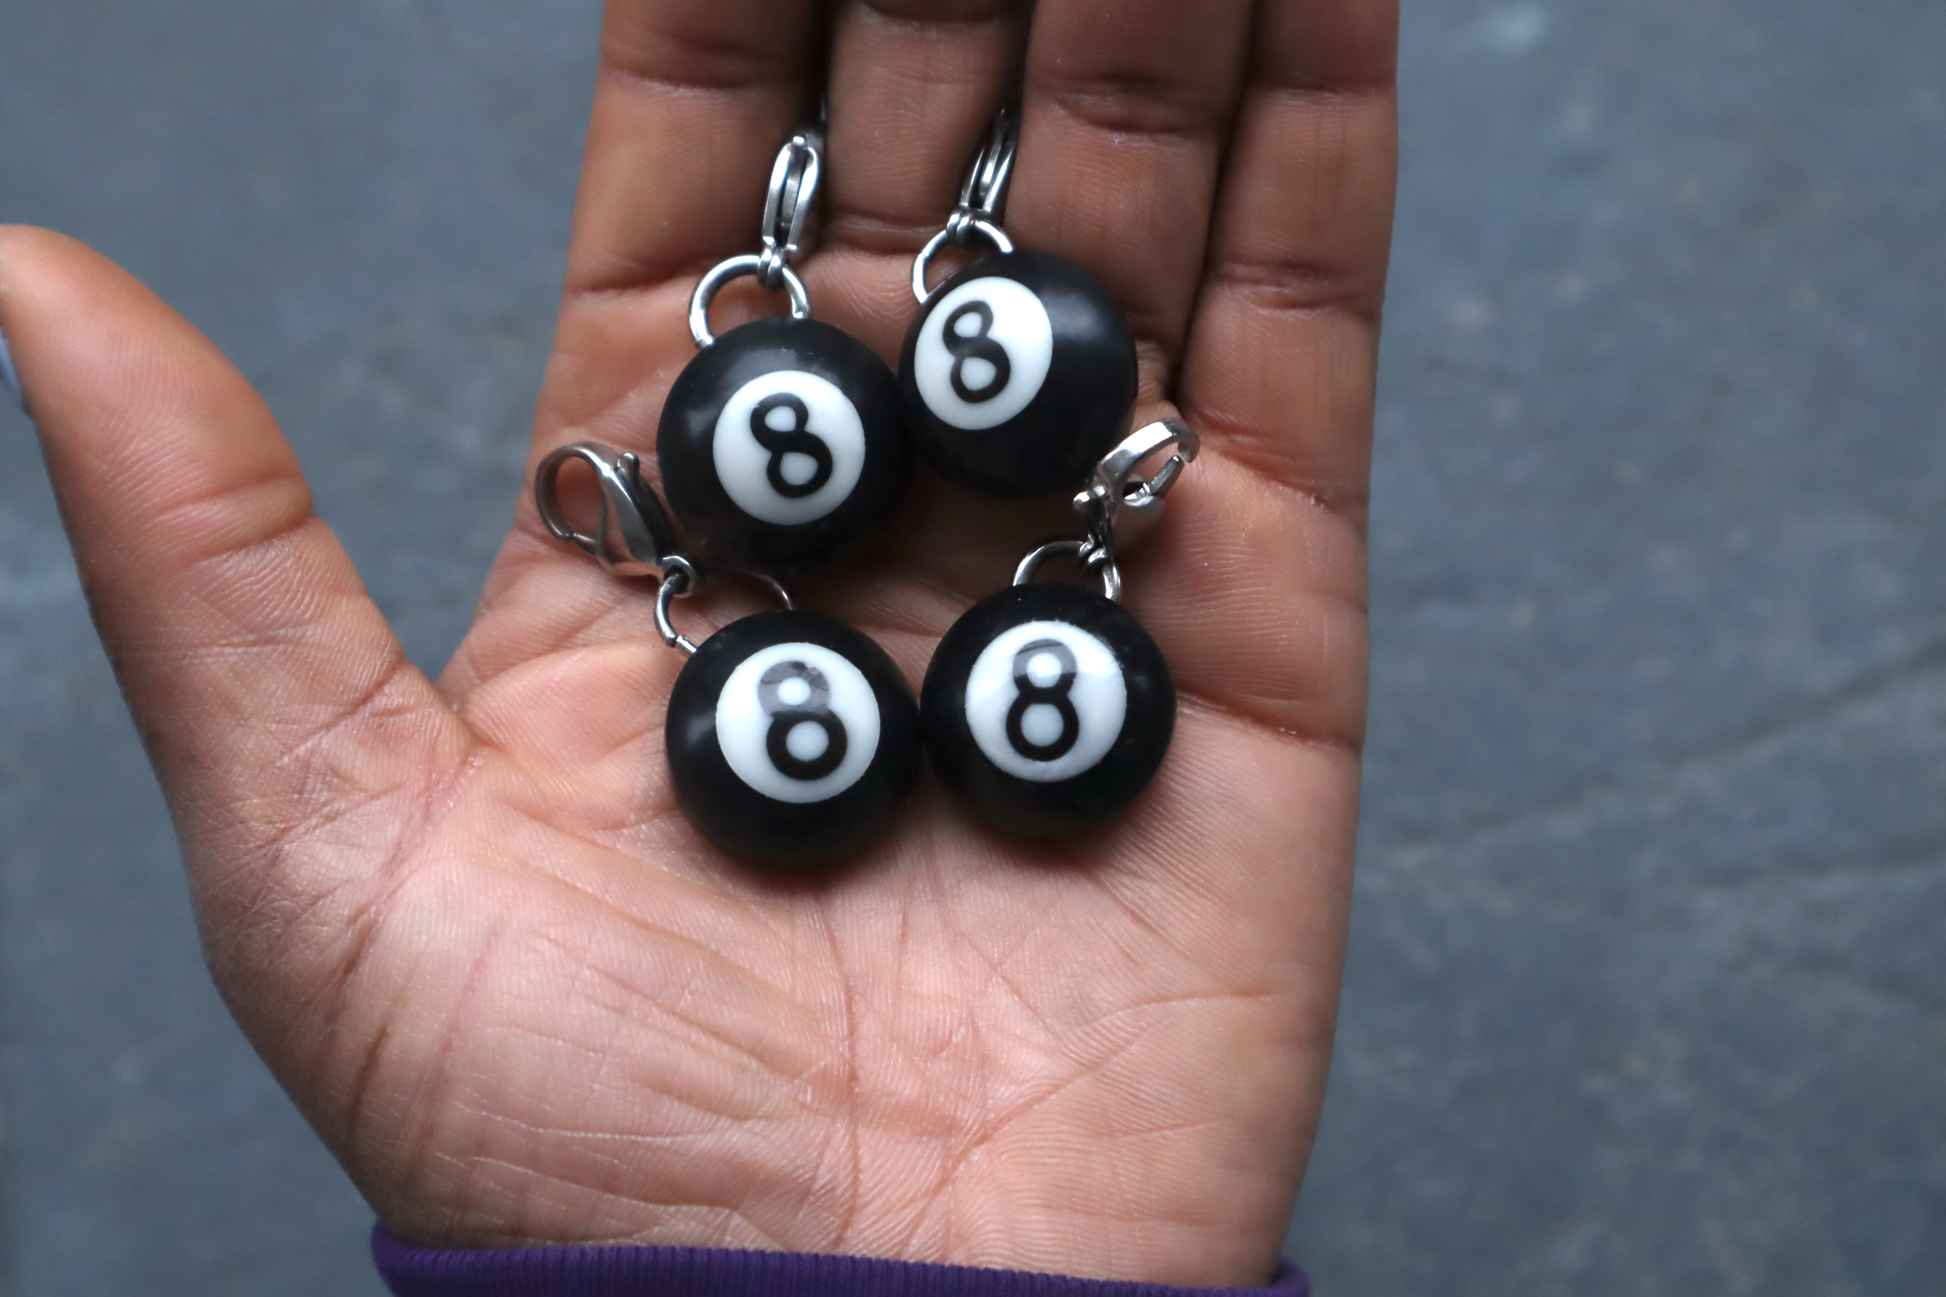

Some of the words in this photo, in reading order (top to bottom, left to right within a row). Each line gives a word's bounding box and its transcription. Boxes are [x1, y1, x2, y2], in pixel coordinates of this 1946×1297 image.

[942, 300, 1011, 403] 8
[750, 392, 833, 498] 8
[757, 660, 848, 781] 8
[1005, 639, 1080, 762] 8
